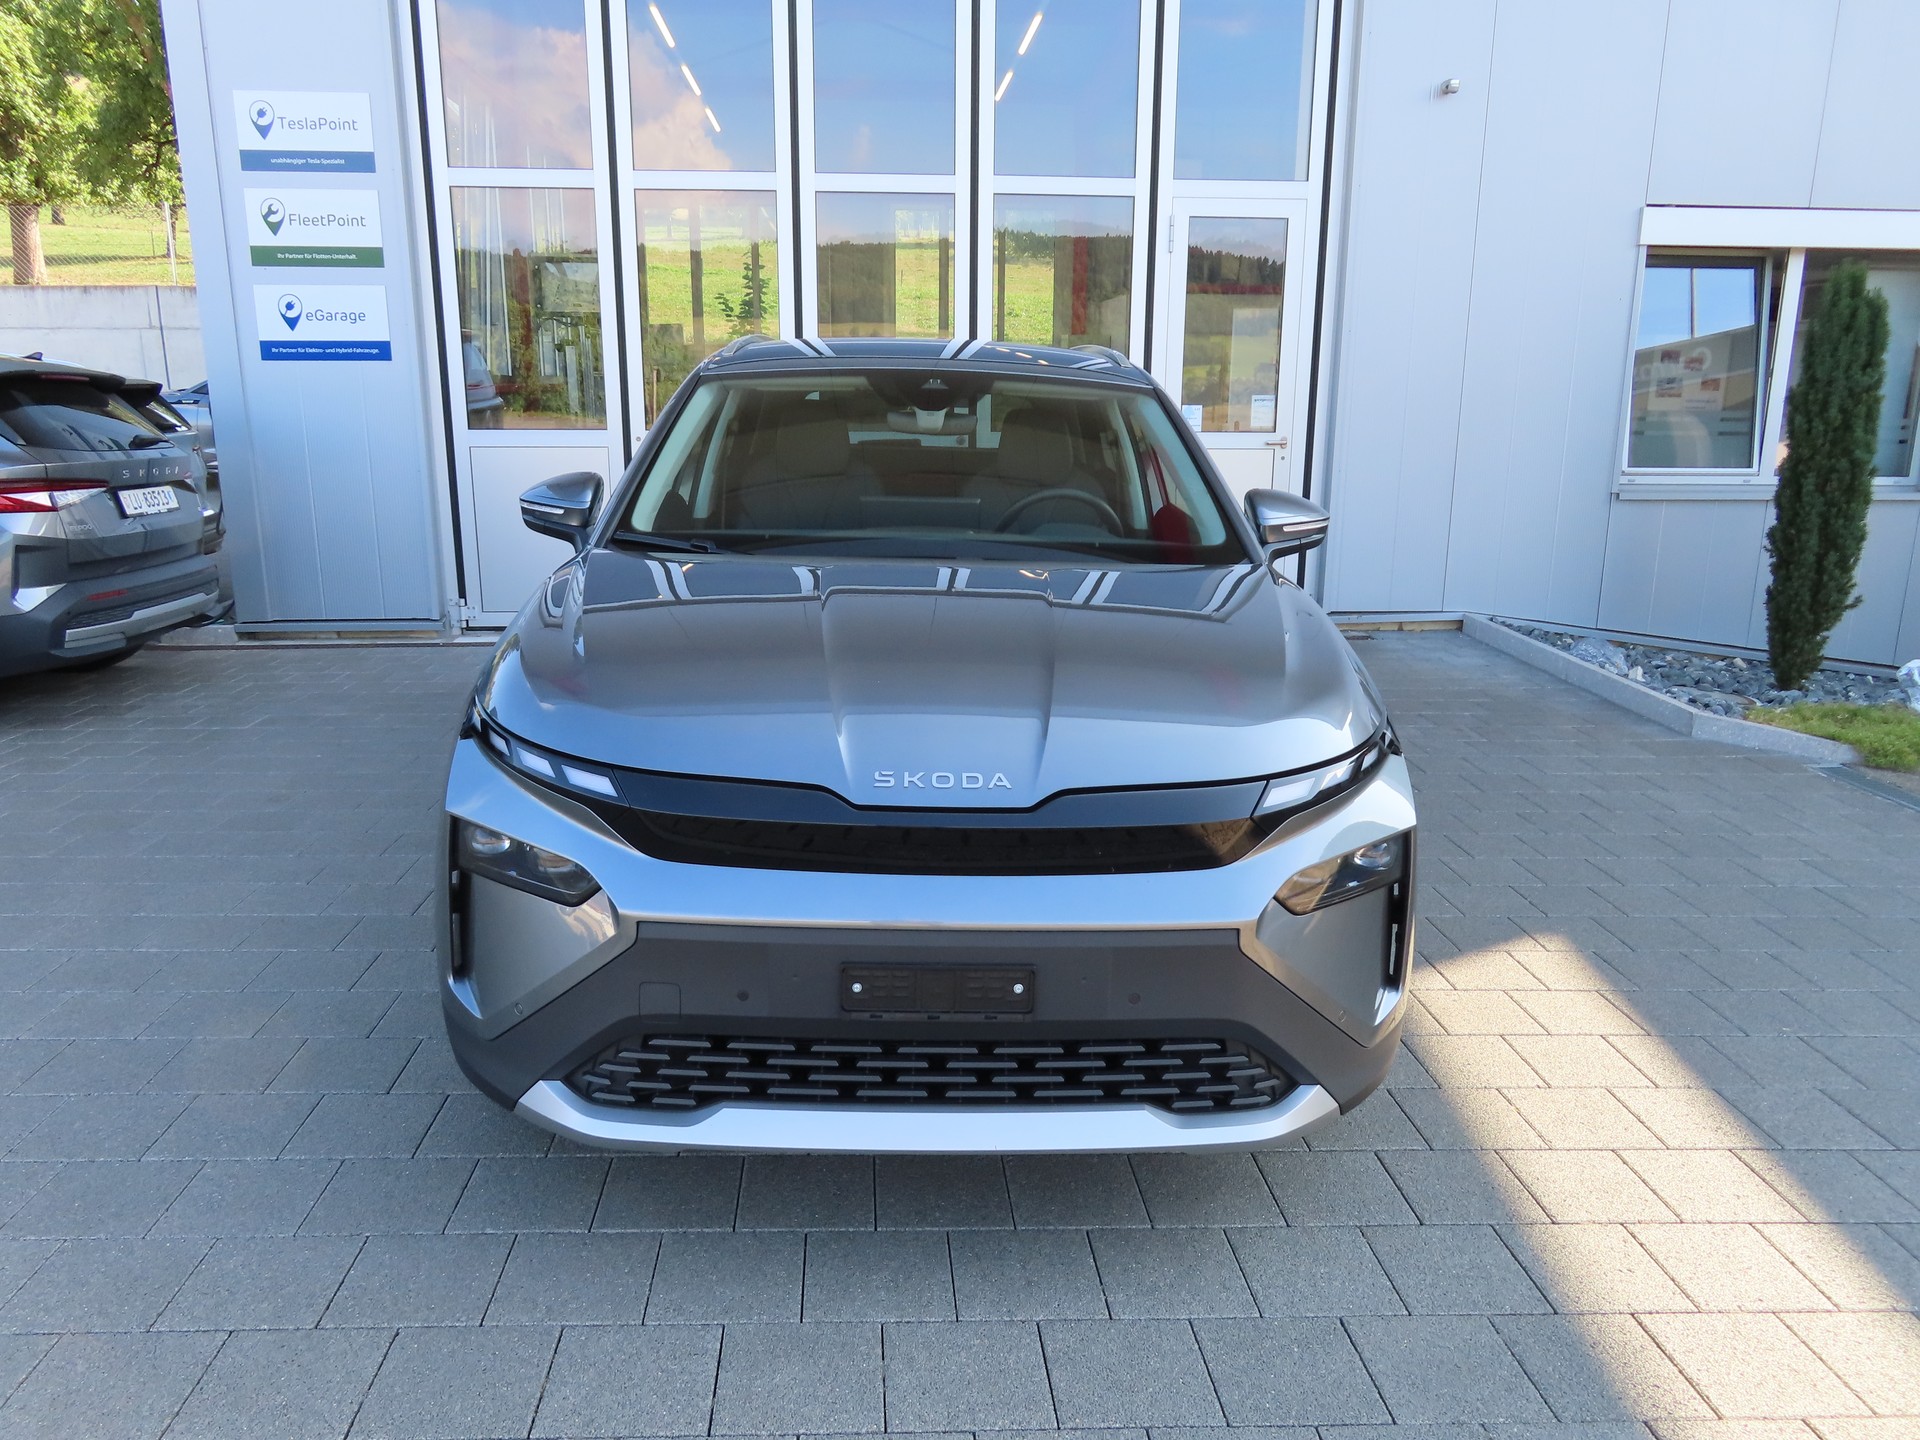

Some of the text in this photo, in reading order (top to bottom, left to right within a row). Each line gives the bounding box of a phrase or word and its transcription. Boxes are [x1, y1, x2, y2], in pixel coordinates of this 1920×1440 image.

[277, 116, 358, 131] TeslaPoint
[270, 157, 306, 165] unabhängiger
[288, 213, 366, 227] FleetPoint
[305, 308, 366, 324] eGarage
